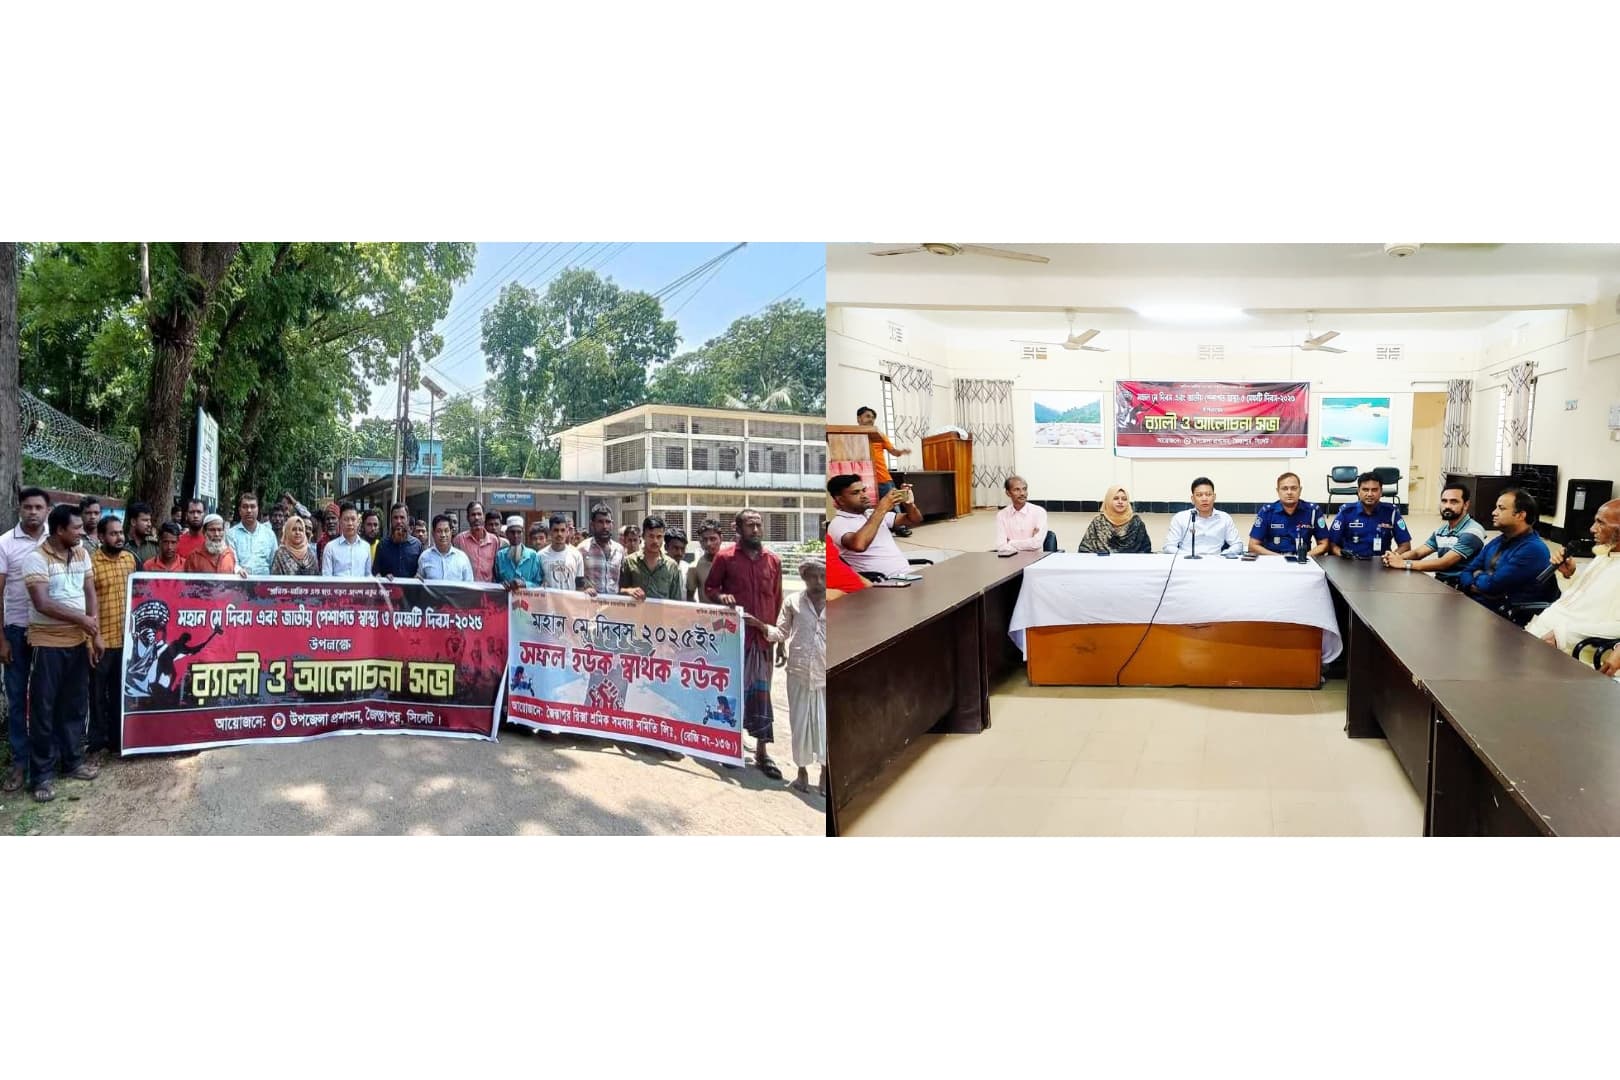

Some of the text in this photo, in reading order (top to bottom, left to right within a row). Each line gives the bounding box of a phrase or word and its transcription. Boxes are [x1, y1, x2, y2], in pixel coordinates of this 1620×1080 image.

[1181, 416, 1190, 430] ও
[1193, 416, 1252, 431] আলোচনা
[1255, 416, 1280, 431] সভা
[178, 609, 206, 627] মহান
[210, 609, 222, 629] মে
[226, 604, 253, 627] দিবস
[256, 610, 278, 626] এবং
[282, 604, 313, 628] জাতীয়
[316, 609, 355, 628] পেশাগত
[382, 611, 389, 626] ও
[392, 606, 423, 630] সেফটি
[425, 606, 483, 630] দিবস-২০২৫
[309, 637, 351, 651] উপলক্ষে
[531, 613, 719, 654] মহান মে দিবস ২০২৫ইং
[519, 641, 730, 692] সফল হউক স্বার্থক হউক
[266, 661, 286, 694] ও
[293, 659, 404, 694] আলোচনা
[408, 661, 456, 697] সভা
[289, 710, 328, 727] উপজেলা
[330, 709, 363, 725] প্রশাসন,
[406, 709, 434, 725] সিলেট
[635, 717, 659, 733] সমিতি
